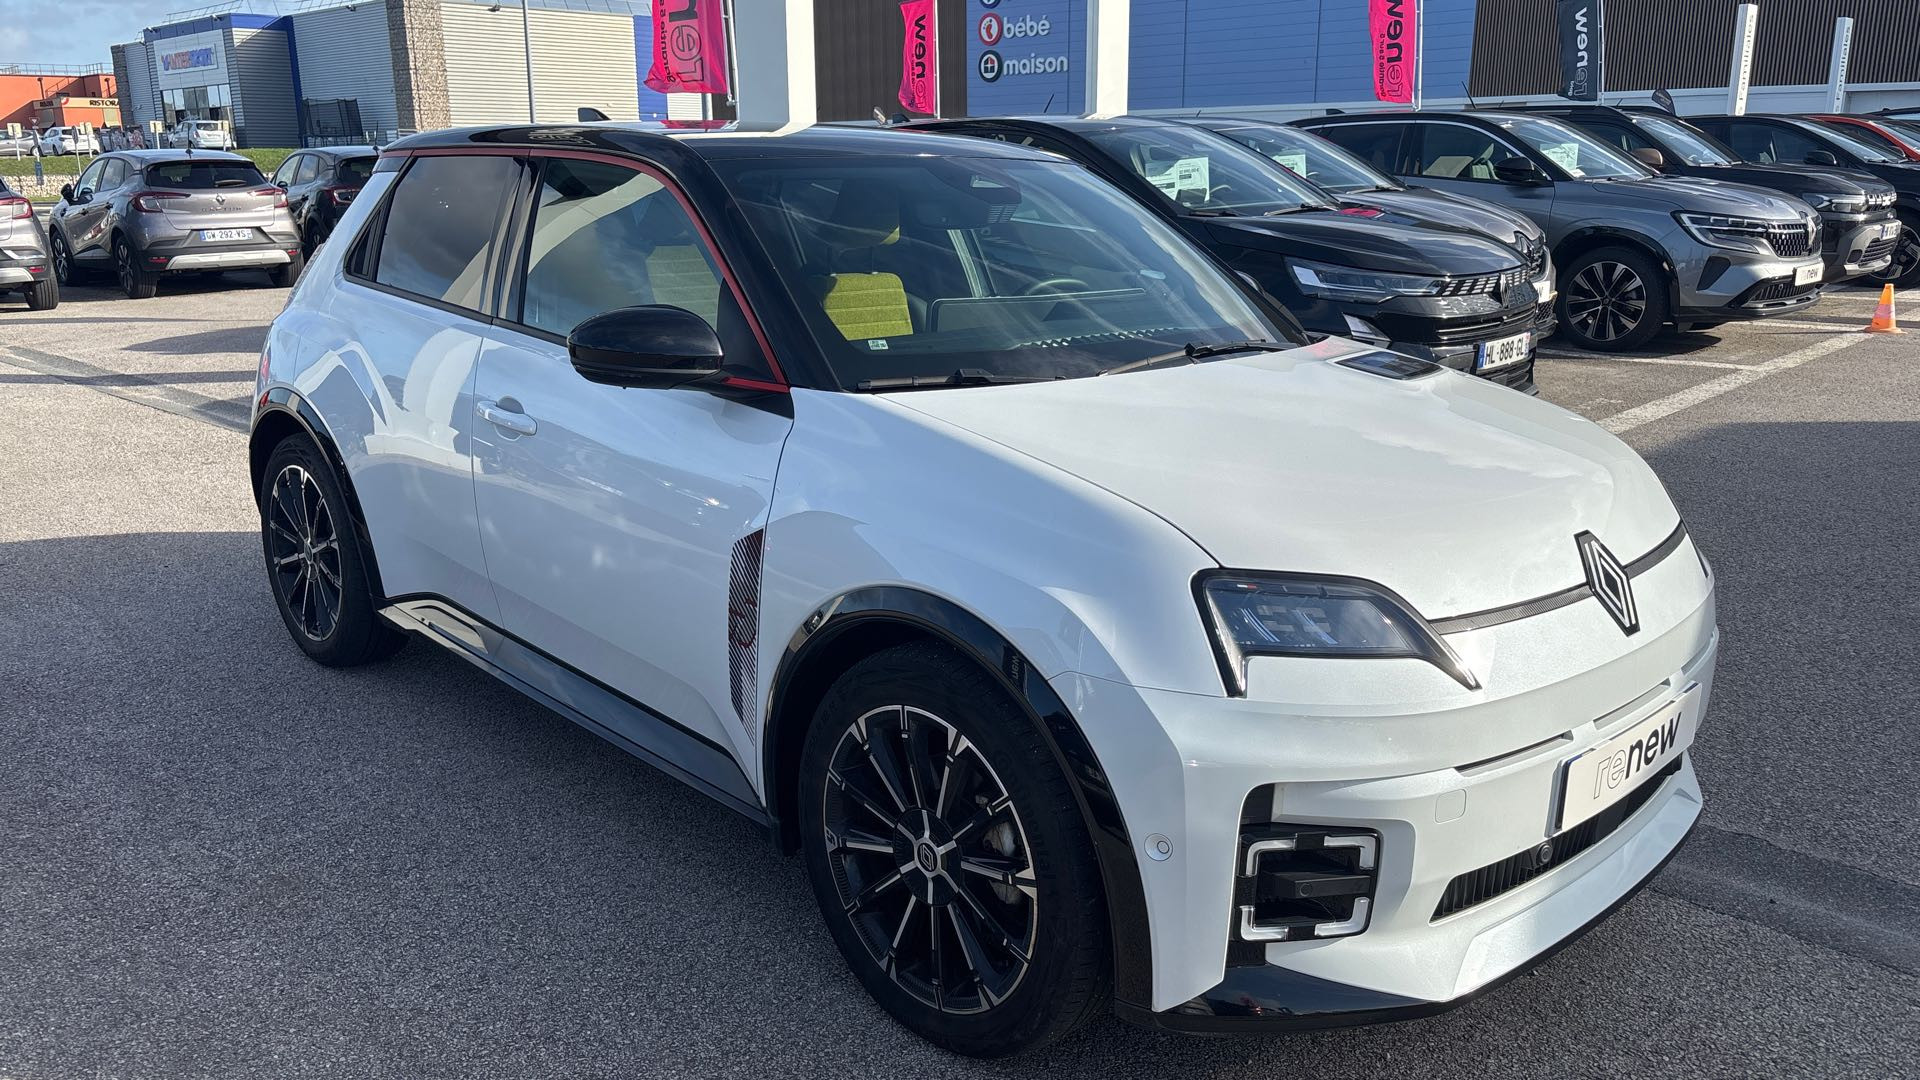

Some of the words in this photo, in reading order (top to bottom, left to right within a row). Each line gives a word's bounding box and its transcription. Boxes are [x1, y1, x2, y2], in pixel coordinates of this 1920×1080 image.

[1003, 14, 1051, 39] bébé
[1003, 52, 1069, 76] maison
[1593, 711, 1682, 800] renew
